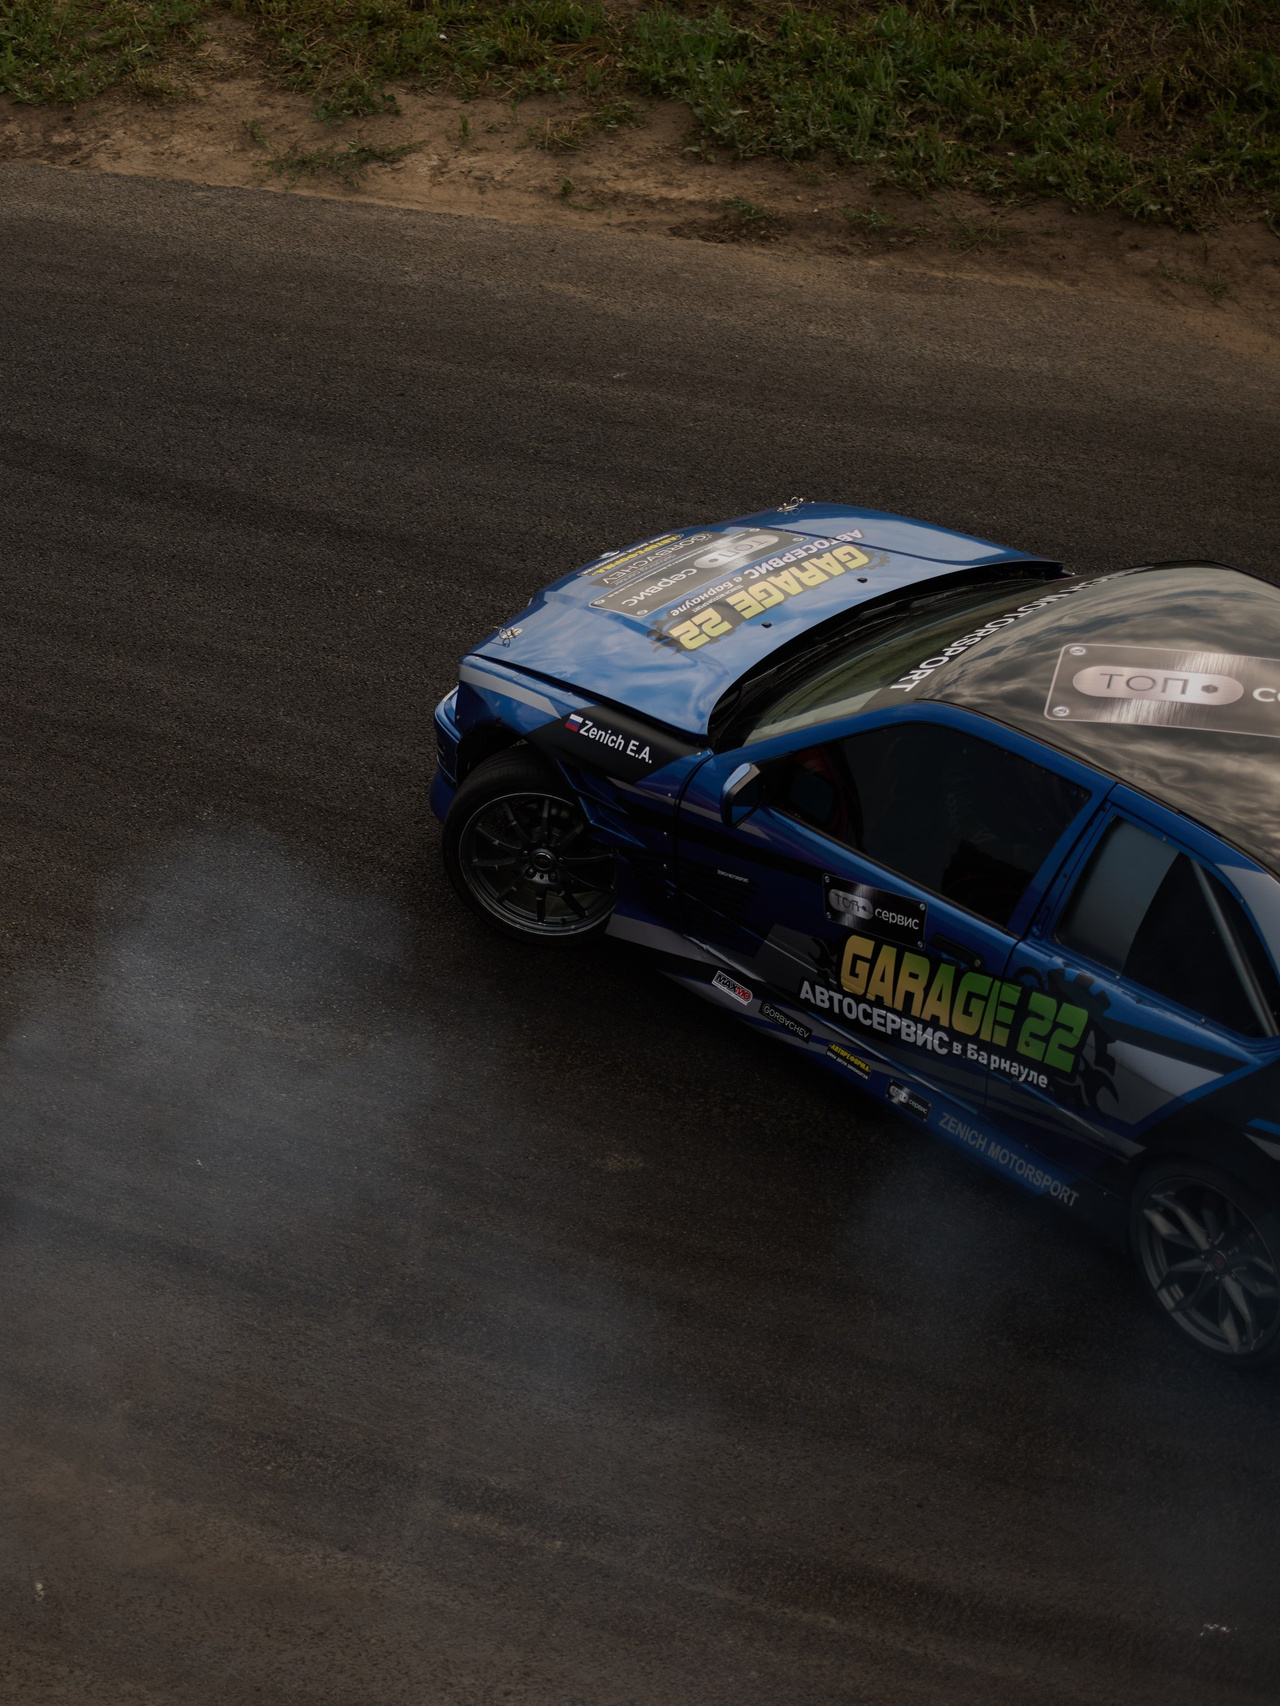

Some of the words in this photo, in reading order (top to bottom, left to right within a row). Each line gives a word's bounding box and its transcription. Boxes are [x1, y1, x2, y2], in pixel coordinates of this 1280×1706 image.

[744, 529, 864, 580] АВТОСЕРВИС
[621, 568, 697, 607] сервис
[670, 580, 732, 618] Барнауле
[727, 545, 870, 620] GARAGE
[669, 607, 732, 650] 22
[889, 593, 1069, 692] MOTORSPORT
[1100, 673, 1189, 695] ТОП
[579, 720, 624, 751] Zenich
[625, 738, 653, 765] E.A.
[834, 893, 861, 914] ТОП
[875, 907, 920, 931] сервис
[840, 934, 1022, 1048] GARAGE
[1016, 991, 1089, 1074] 22
[799, 980, 950, 1056] АВТОСЕРВИС
[966, 1042, 1049, 1090] Барнауле
[938, 1111, 986, 1153] ZENICH
[989, 1144, 1079, 1208] MOTORSPORT
